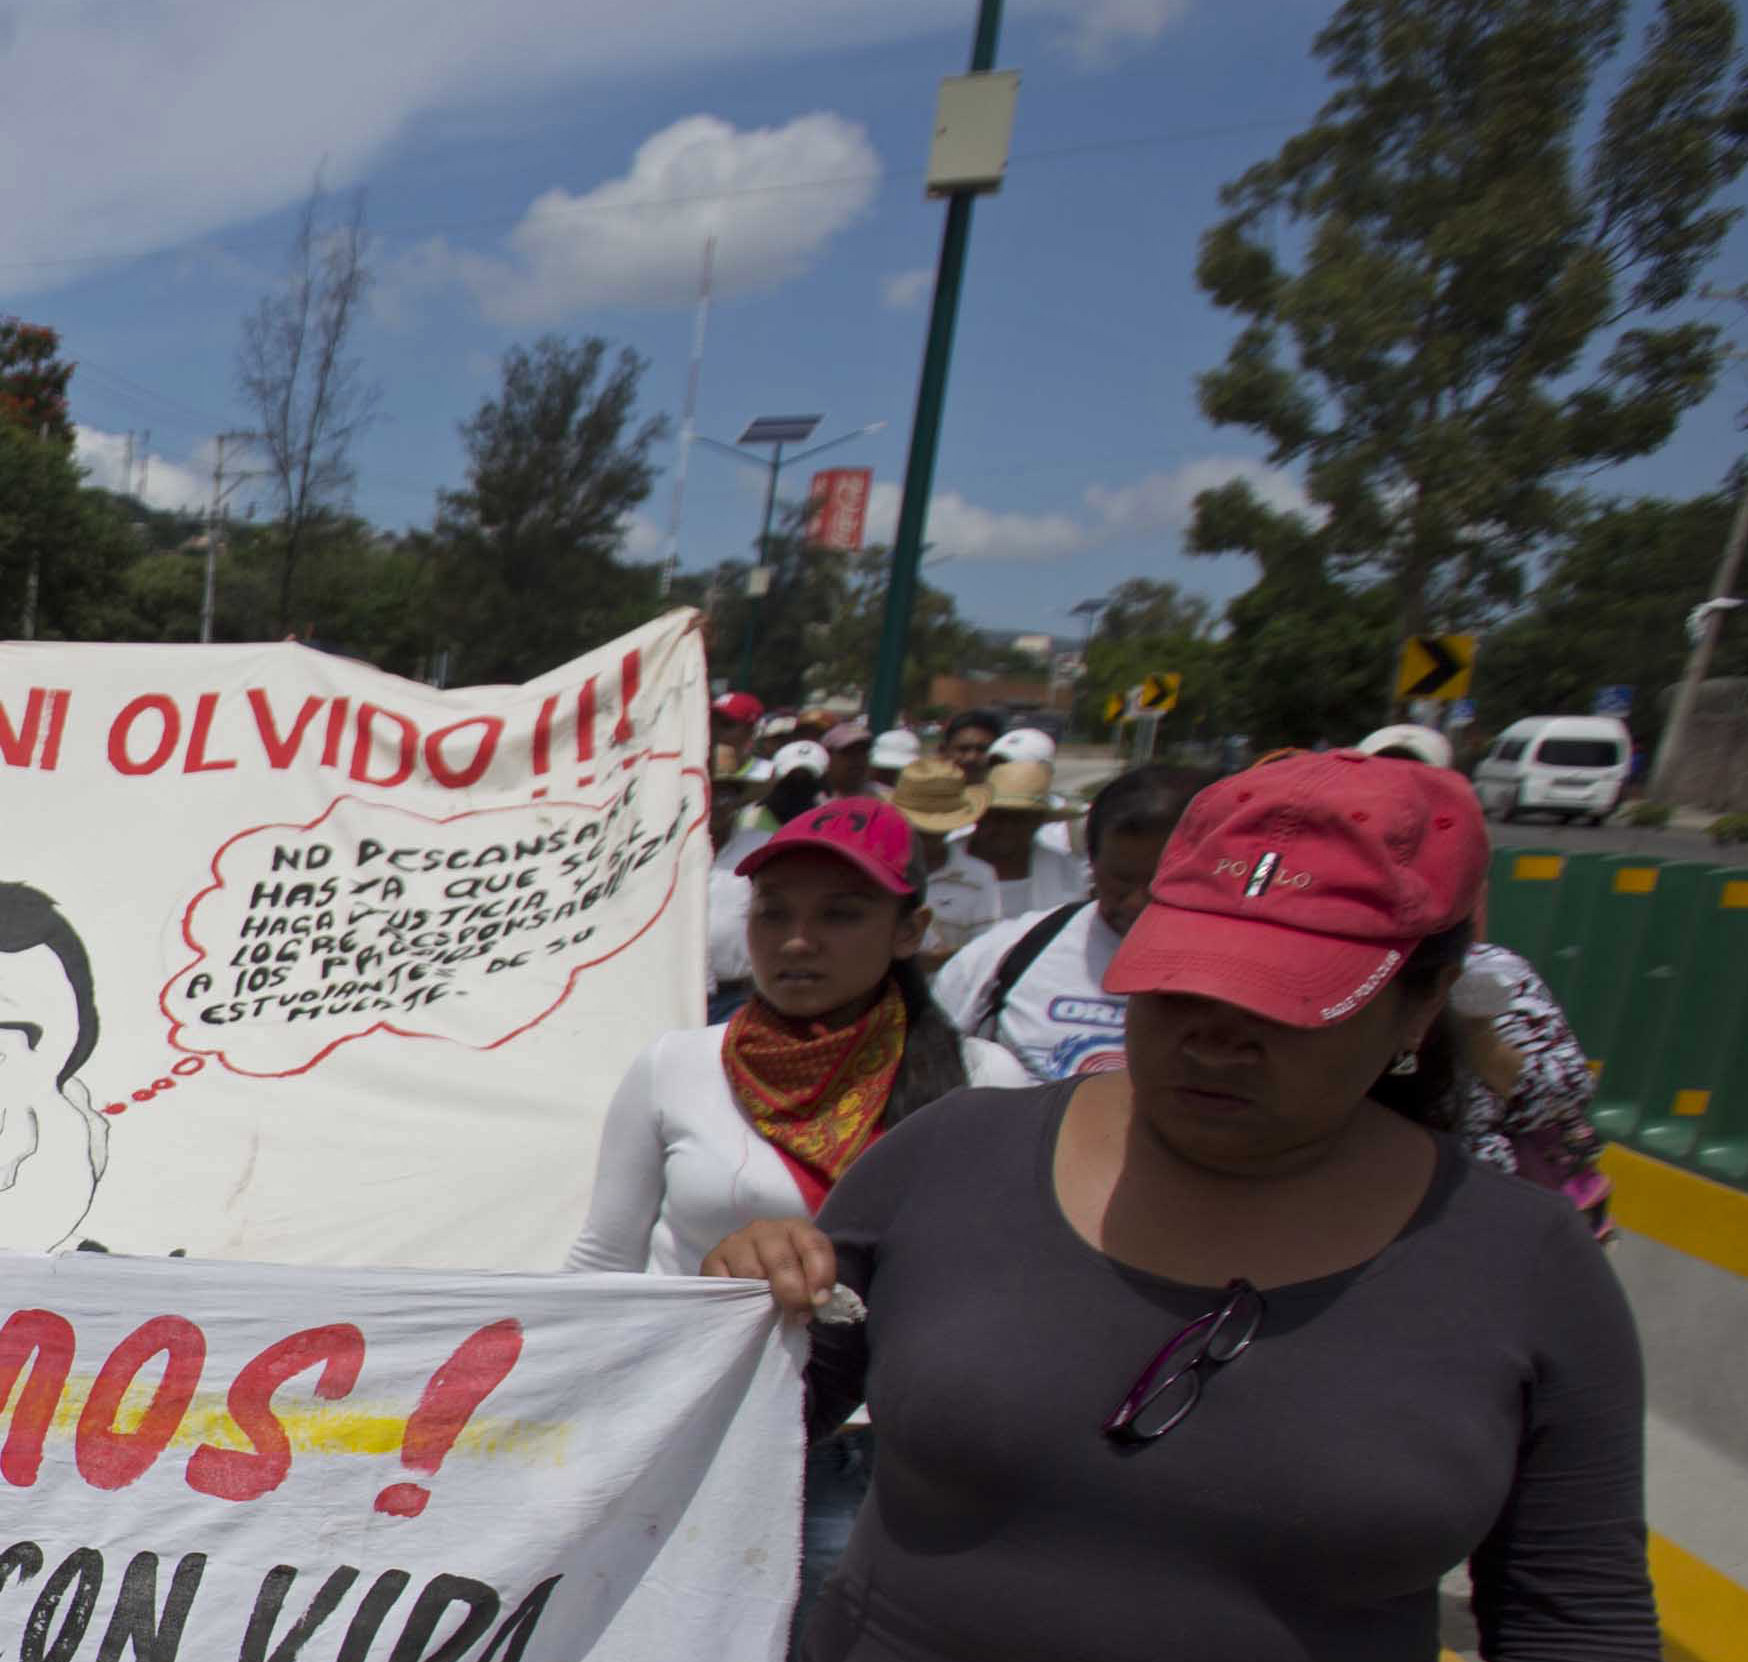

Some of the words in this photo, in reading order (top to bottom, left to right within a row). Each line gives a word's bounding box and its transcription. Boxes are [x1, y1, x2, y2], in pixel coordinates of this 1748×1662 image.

[271, 842, 332, 872] NO
[249, 876, 404, 910] HASTA
[444, 867, 538, 898] QUE
[240, 910, 335, 939] HAGA
[348, 889, 548, 932] JUSTICIA
[230, 930, 358, 967] LOGRE
[186, 972, 213, 999] A
